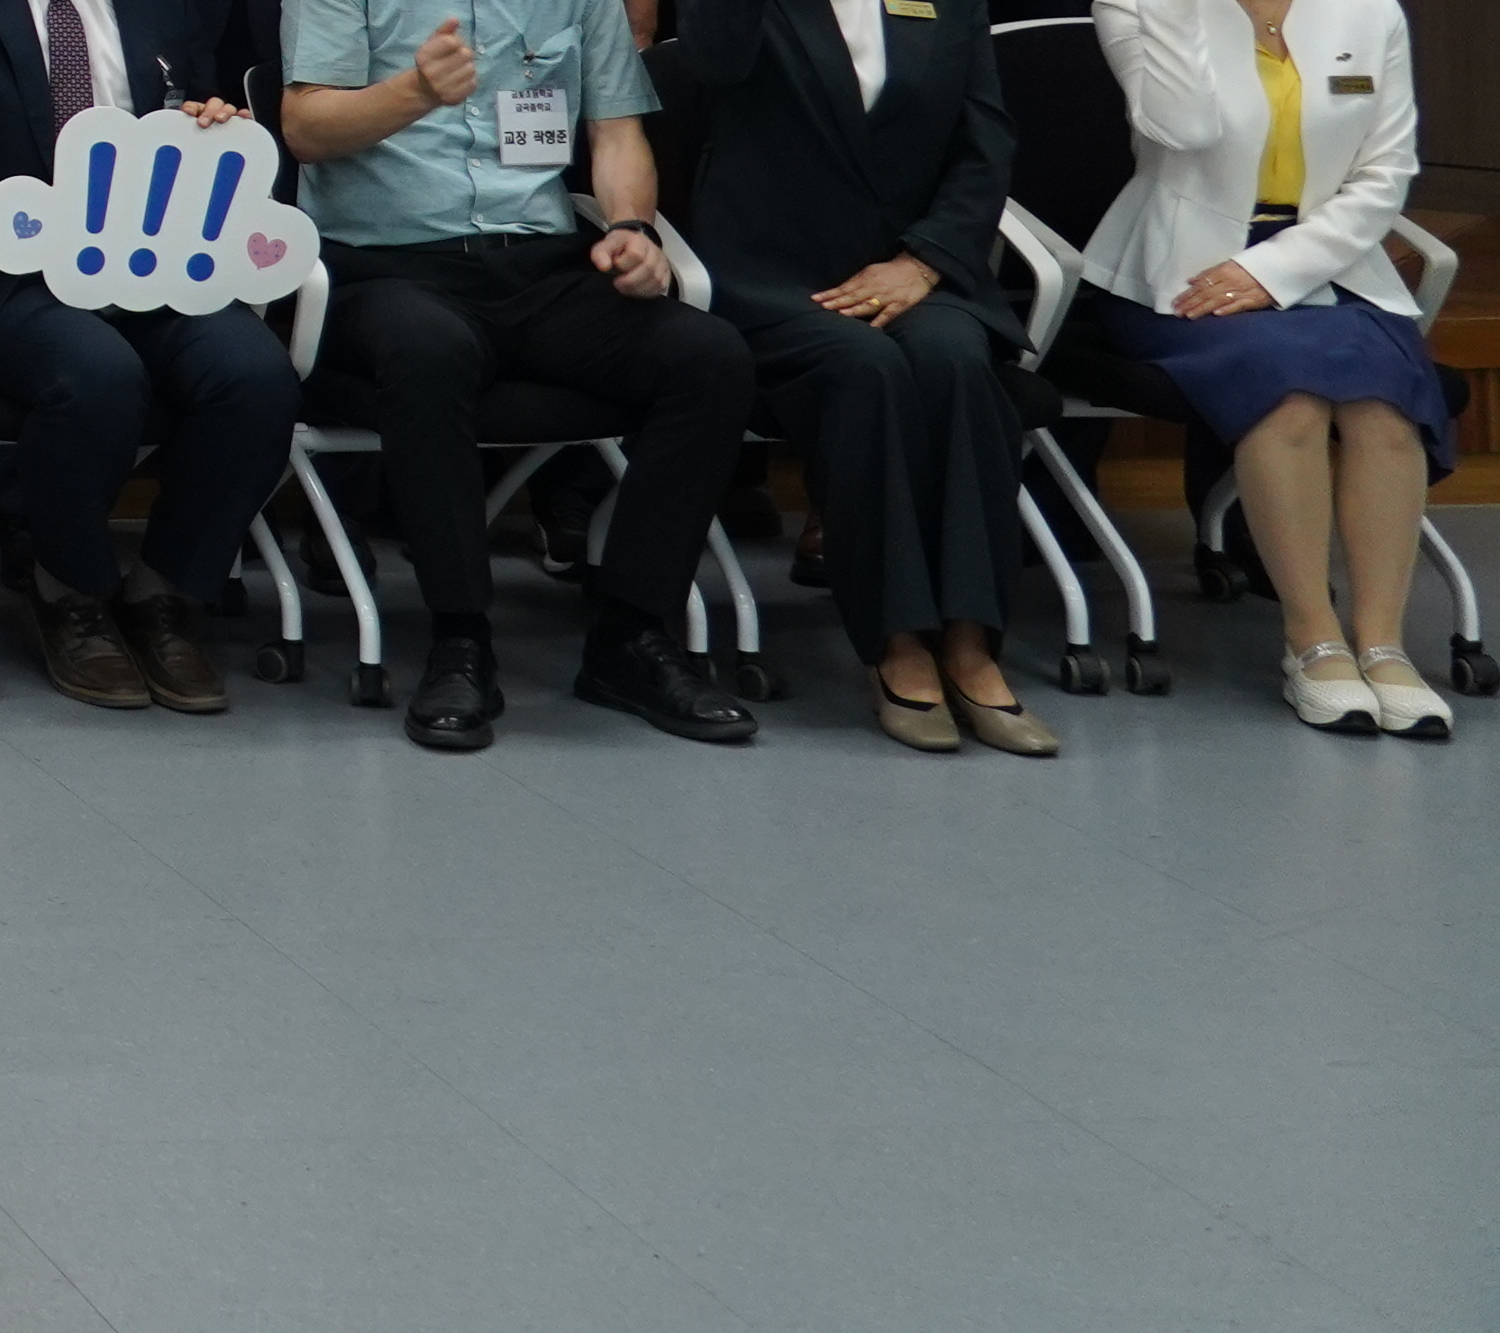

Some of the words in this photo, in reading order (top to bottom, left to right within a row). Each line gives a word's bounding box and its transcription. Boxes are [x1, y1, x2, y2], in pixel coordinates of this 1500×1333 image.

[505, 131, 526, 145] 교장
[534, 130, 566, 144] 곽형준
[77, 141, 243, 283] !!!
